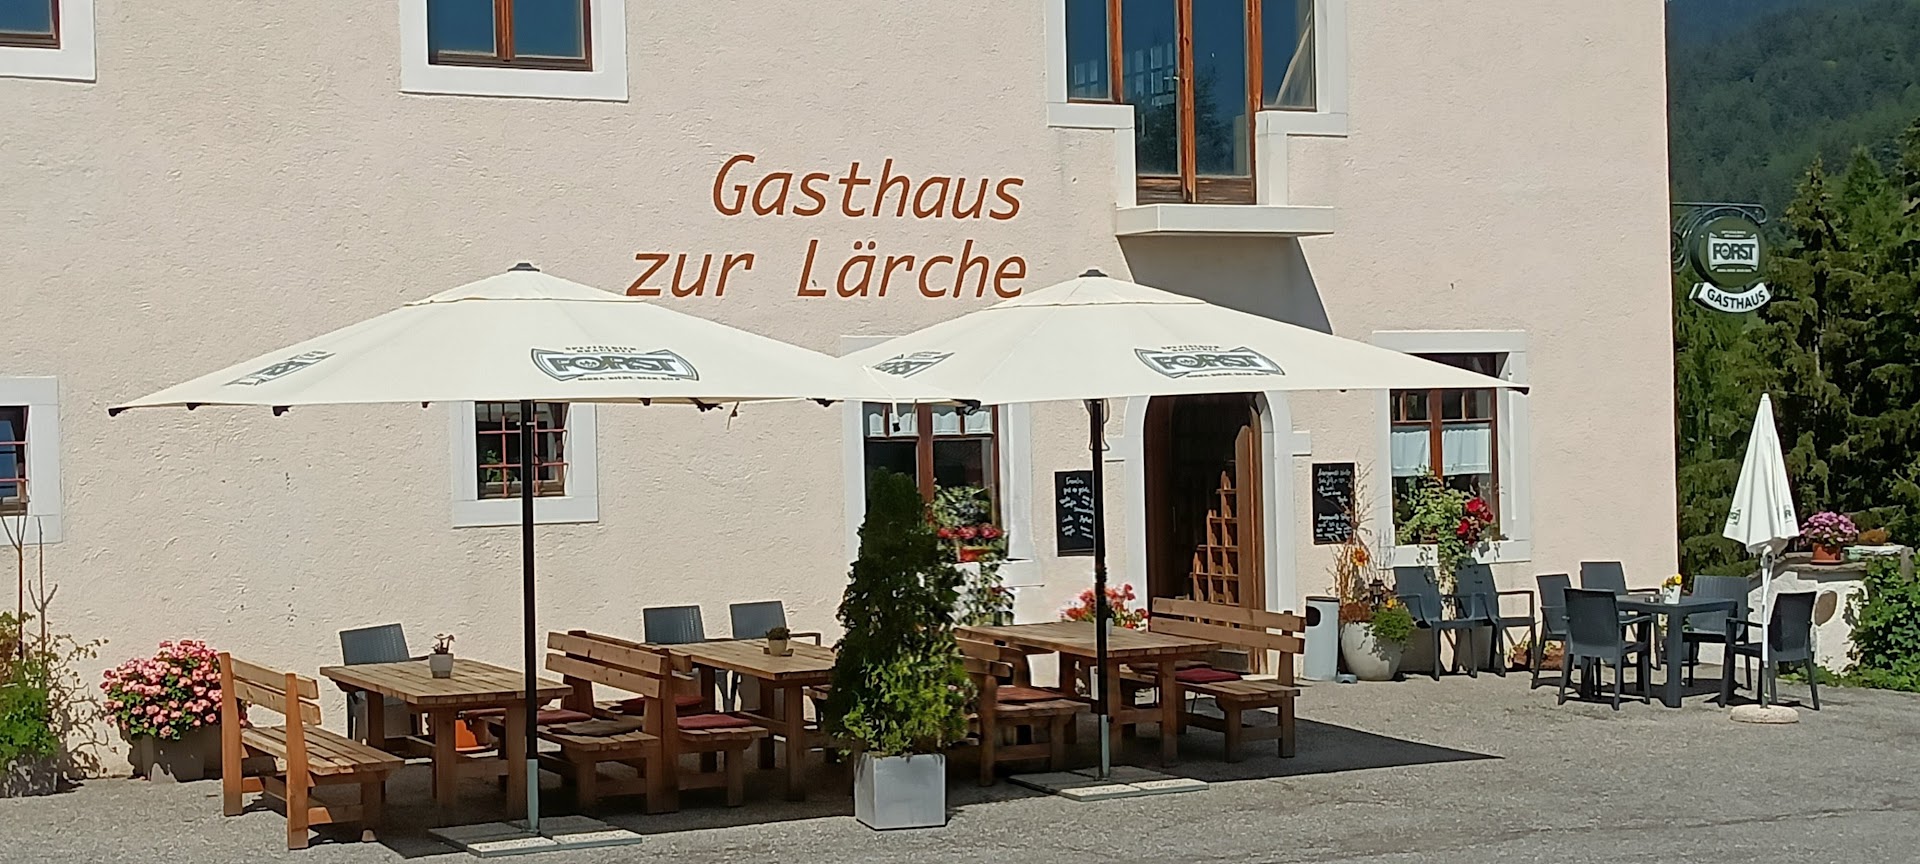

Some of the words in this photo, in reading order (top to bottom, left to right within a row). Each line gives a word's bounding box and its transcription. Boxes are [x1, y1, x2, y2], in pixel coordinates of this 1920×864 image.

[713, 154, 1024, 220] Gasthaus
[1713, 243, 1755, 259] FORST
[626, 252, 755, 298] zur
[797, 239, 1027, 299] Lärche
[1707, 289, 1765, 309] GASTHAUS
[548, 356, 676, 371] FORST
[1152, 354, 1261, 369] FORST
